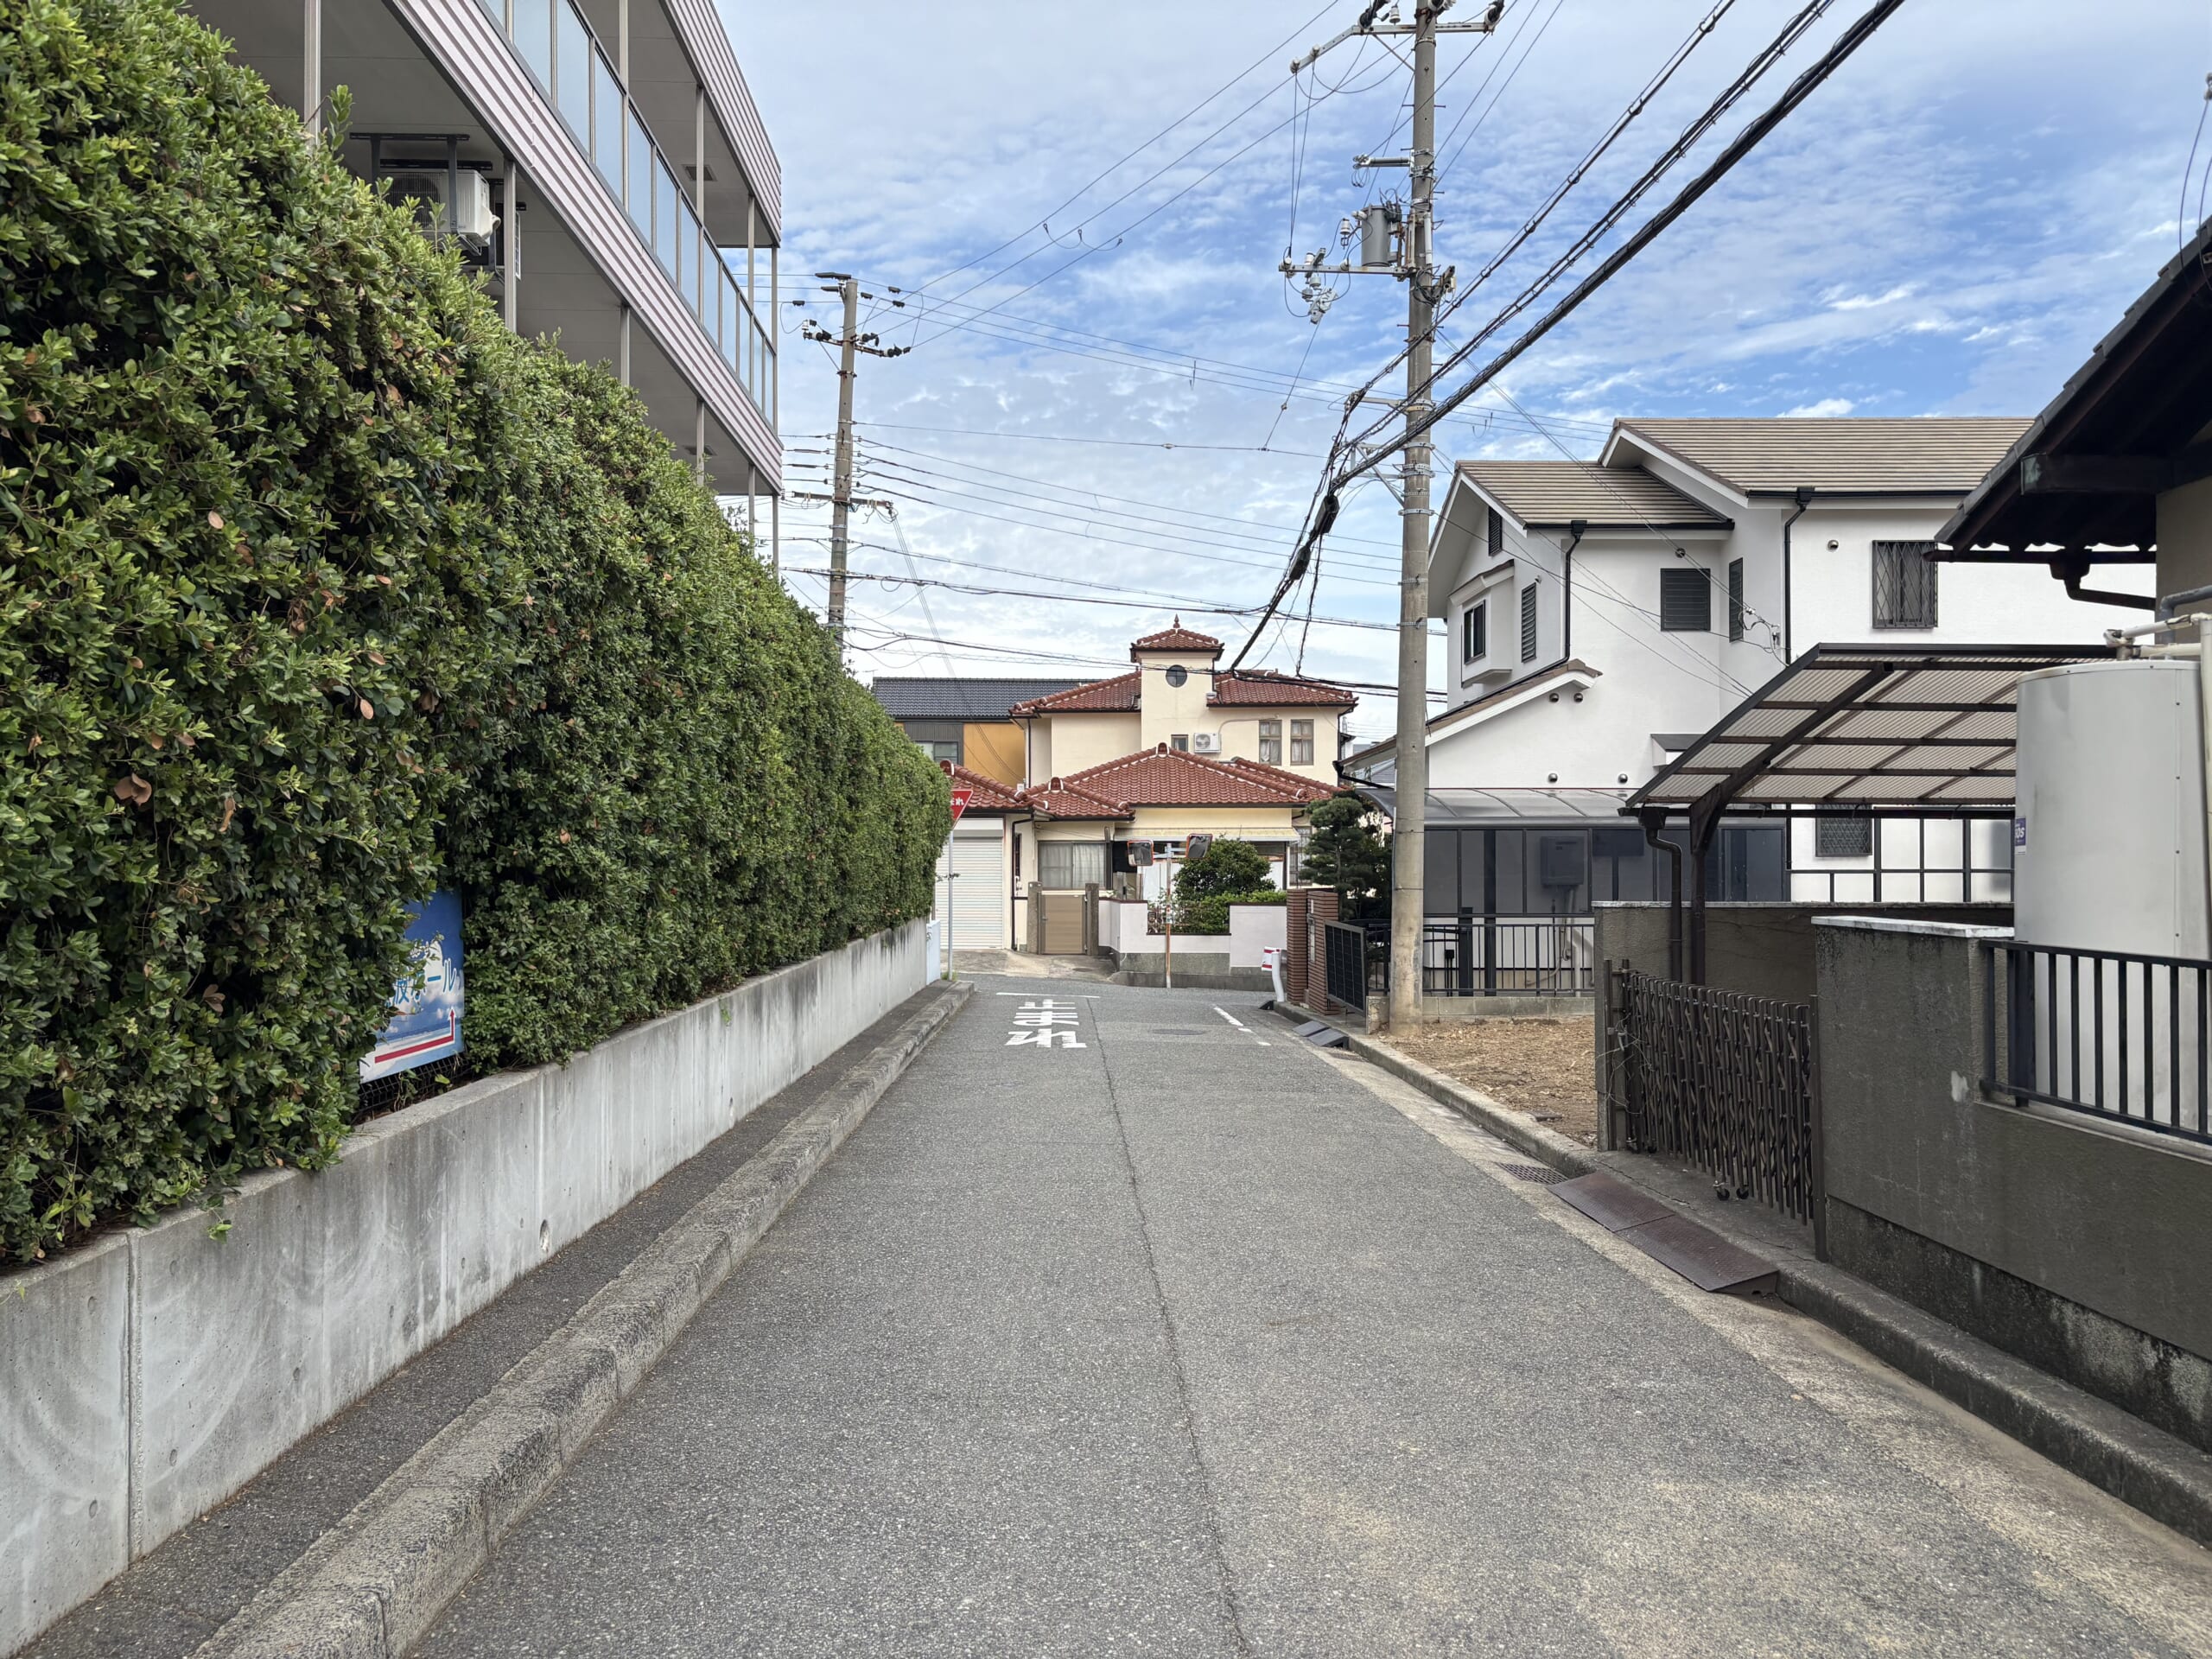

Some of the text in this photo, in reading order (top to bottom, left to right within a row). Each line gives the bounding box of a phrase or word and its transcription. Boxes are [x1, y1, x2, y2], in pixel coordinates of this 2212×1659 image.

[950, 797, 964, 806] まれ
[1004, 999, 1088, 1048] 止まれ
